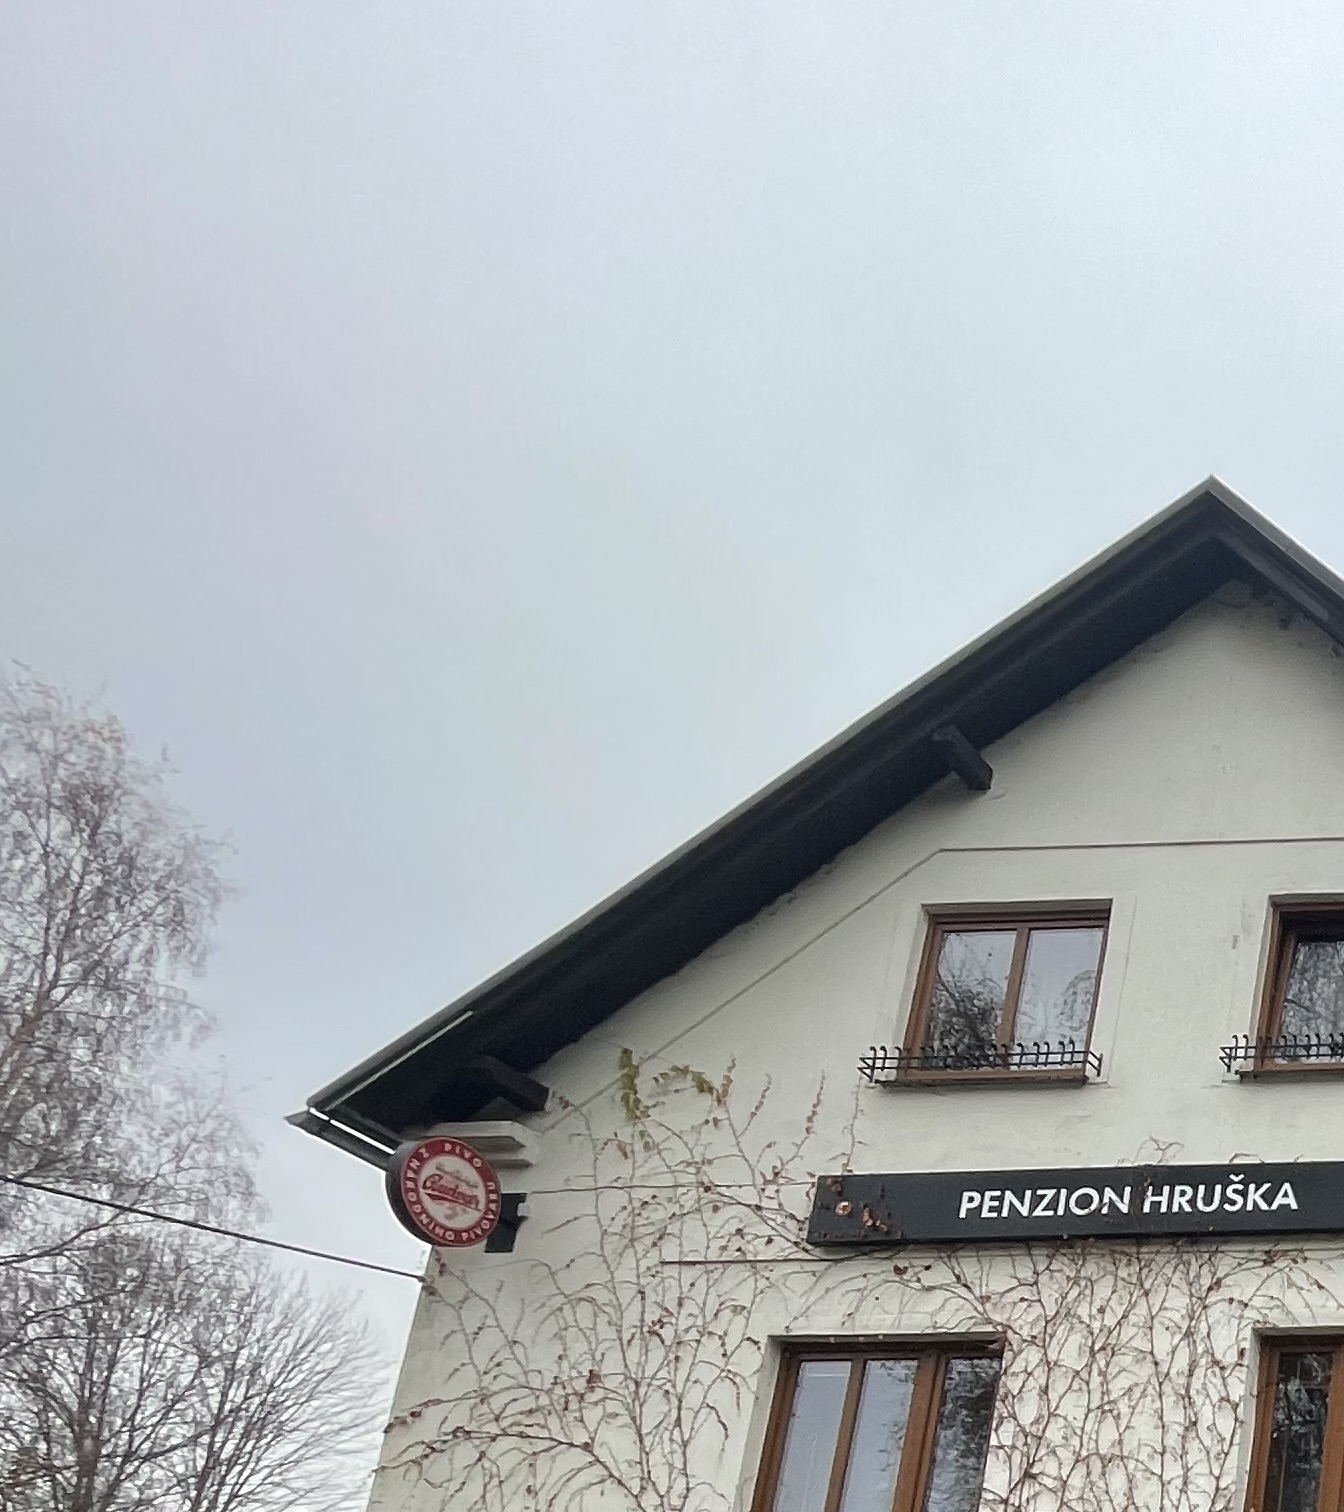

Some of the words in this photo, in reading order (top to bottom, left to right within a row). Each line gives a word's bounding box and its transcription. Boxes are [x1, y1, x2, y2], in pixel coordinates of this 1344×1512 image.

[444, 1143, 483, 1168] PIVO
[461, 1181, 499, 1241] PIVOVARU
[957, 1185, 1133, 1220] PENZION
[1142, 1173, 1300, 1214] HRUŠKA
